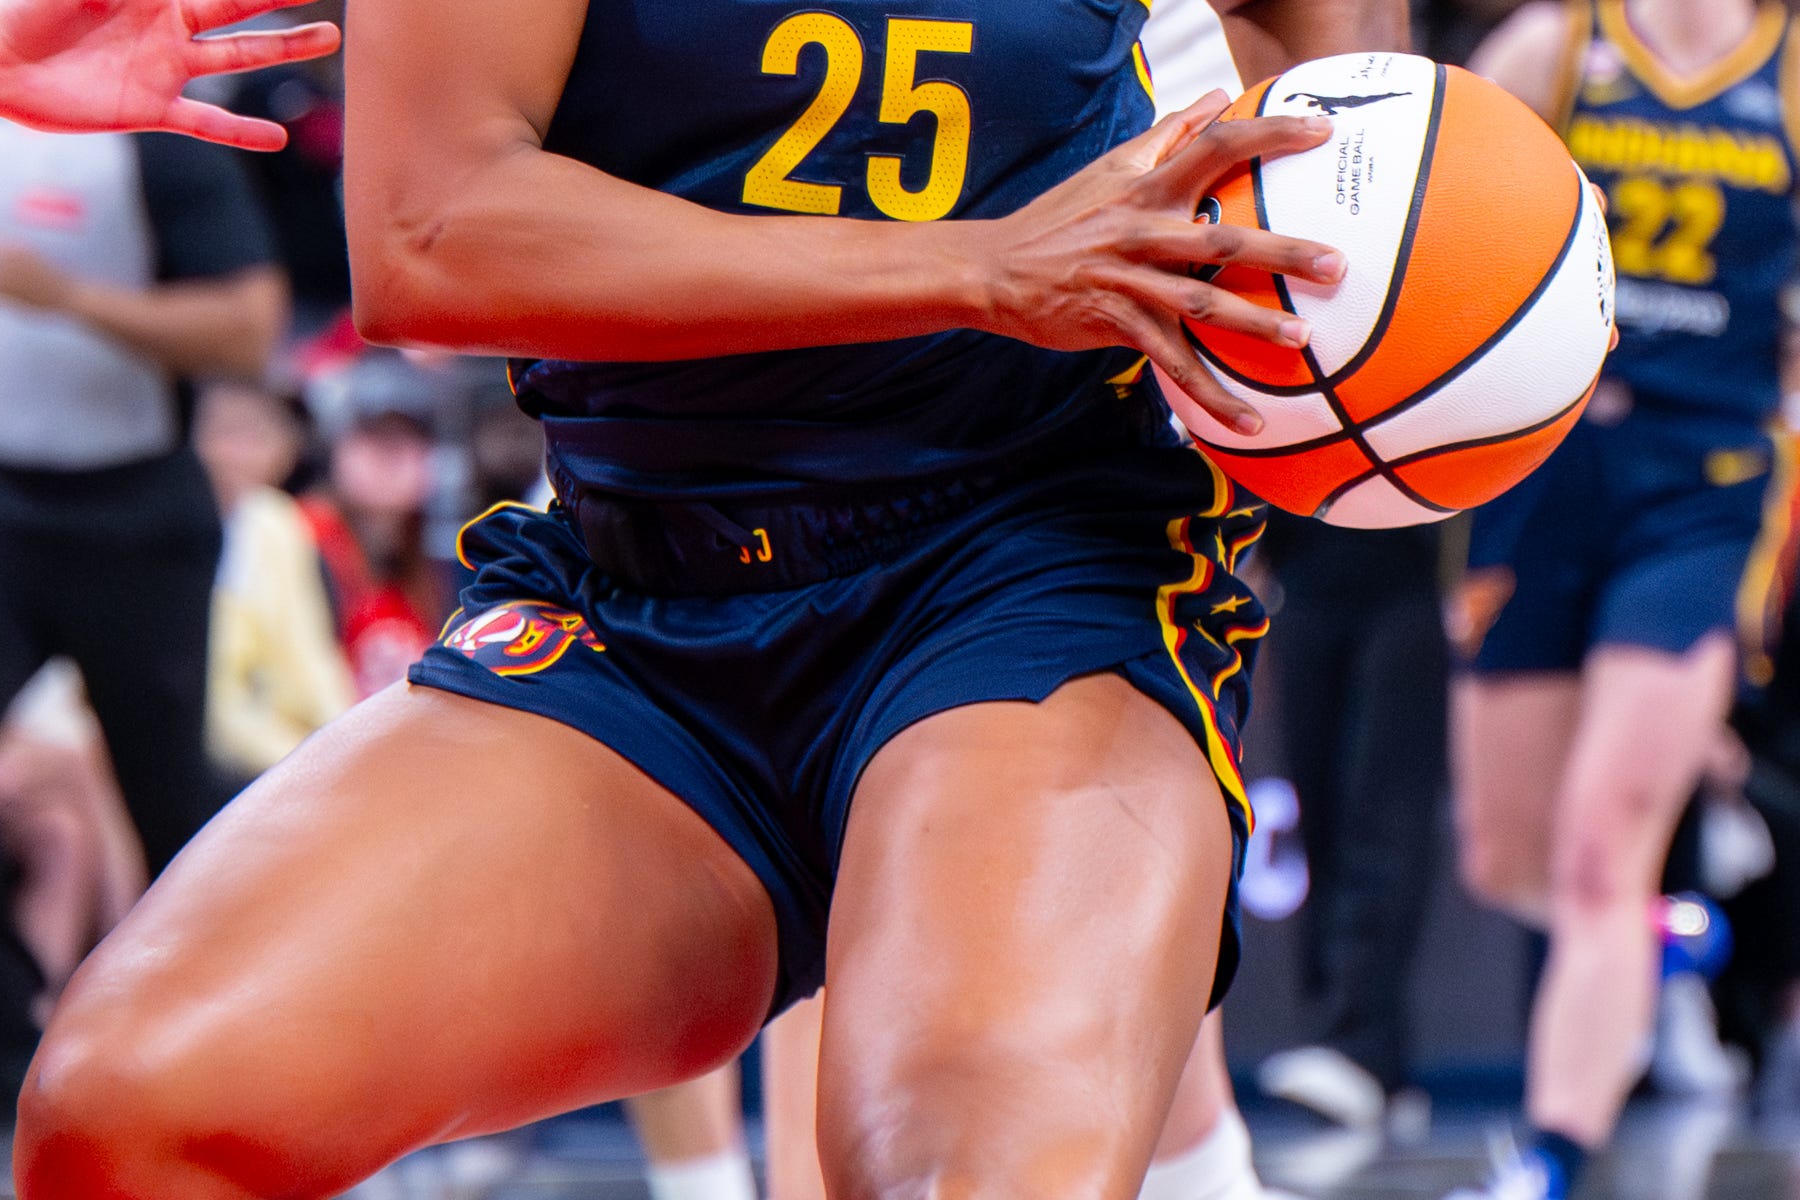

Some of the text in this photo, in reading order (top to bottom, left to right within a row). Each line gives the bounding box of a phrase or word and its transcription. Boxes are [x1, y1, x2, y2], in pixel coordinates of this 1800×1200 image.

[742, 12, 973, 223] 25
[1336, 136, 1349, 205] OFFICIAL
[1350, 128, 1365, 215] GAME BALL
